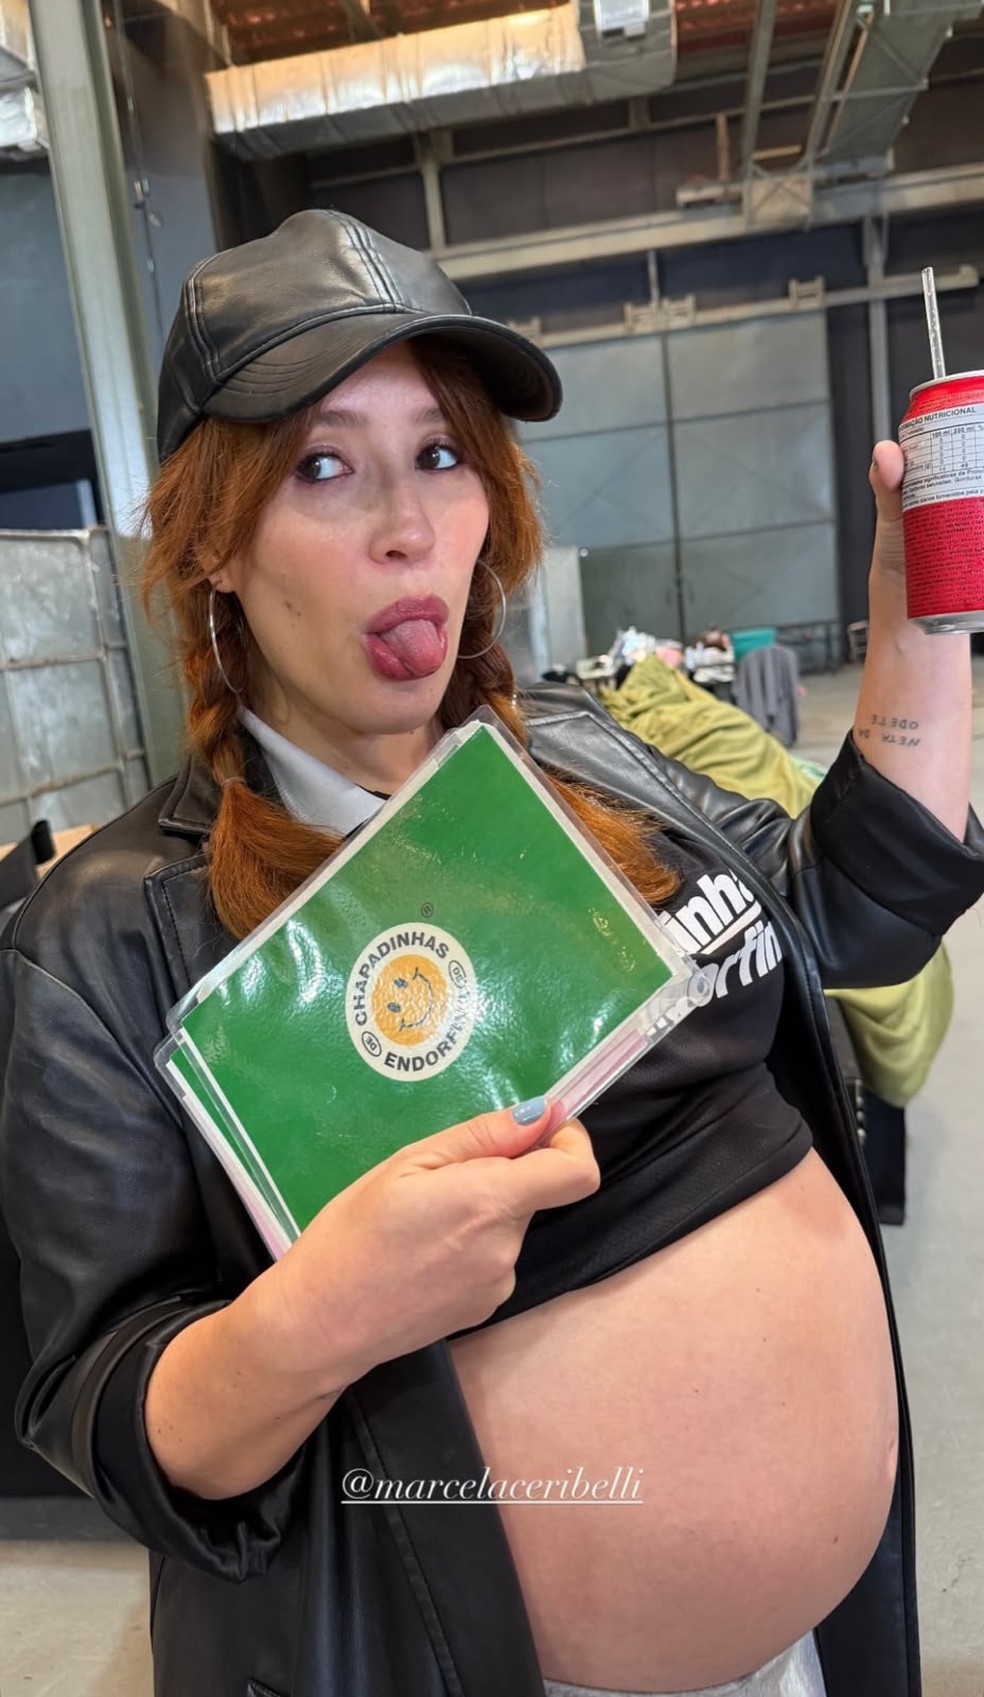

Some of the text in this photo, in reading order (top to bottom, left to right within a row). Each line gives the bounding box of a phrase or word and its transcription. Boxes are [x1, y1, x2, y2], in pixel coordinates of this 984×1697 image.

[924, 407, 976, 422] NUTRICIONAL
[871, 714, 919, 729] ODETE
[881, 733, 920, 746] NETA
[659, 869, 755, 954] inh
[353, 931, 450, 1026] CHAPADINHAS
